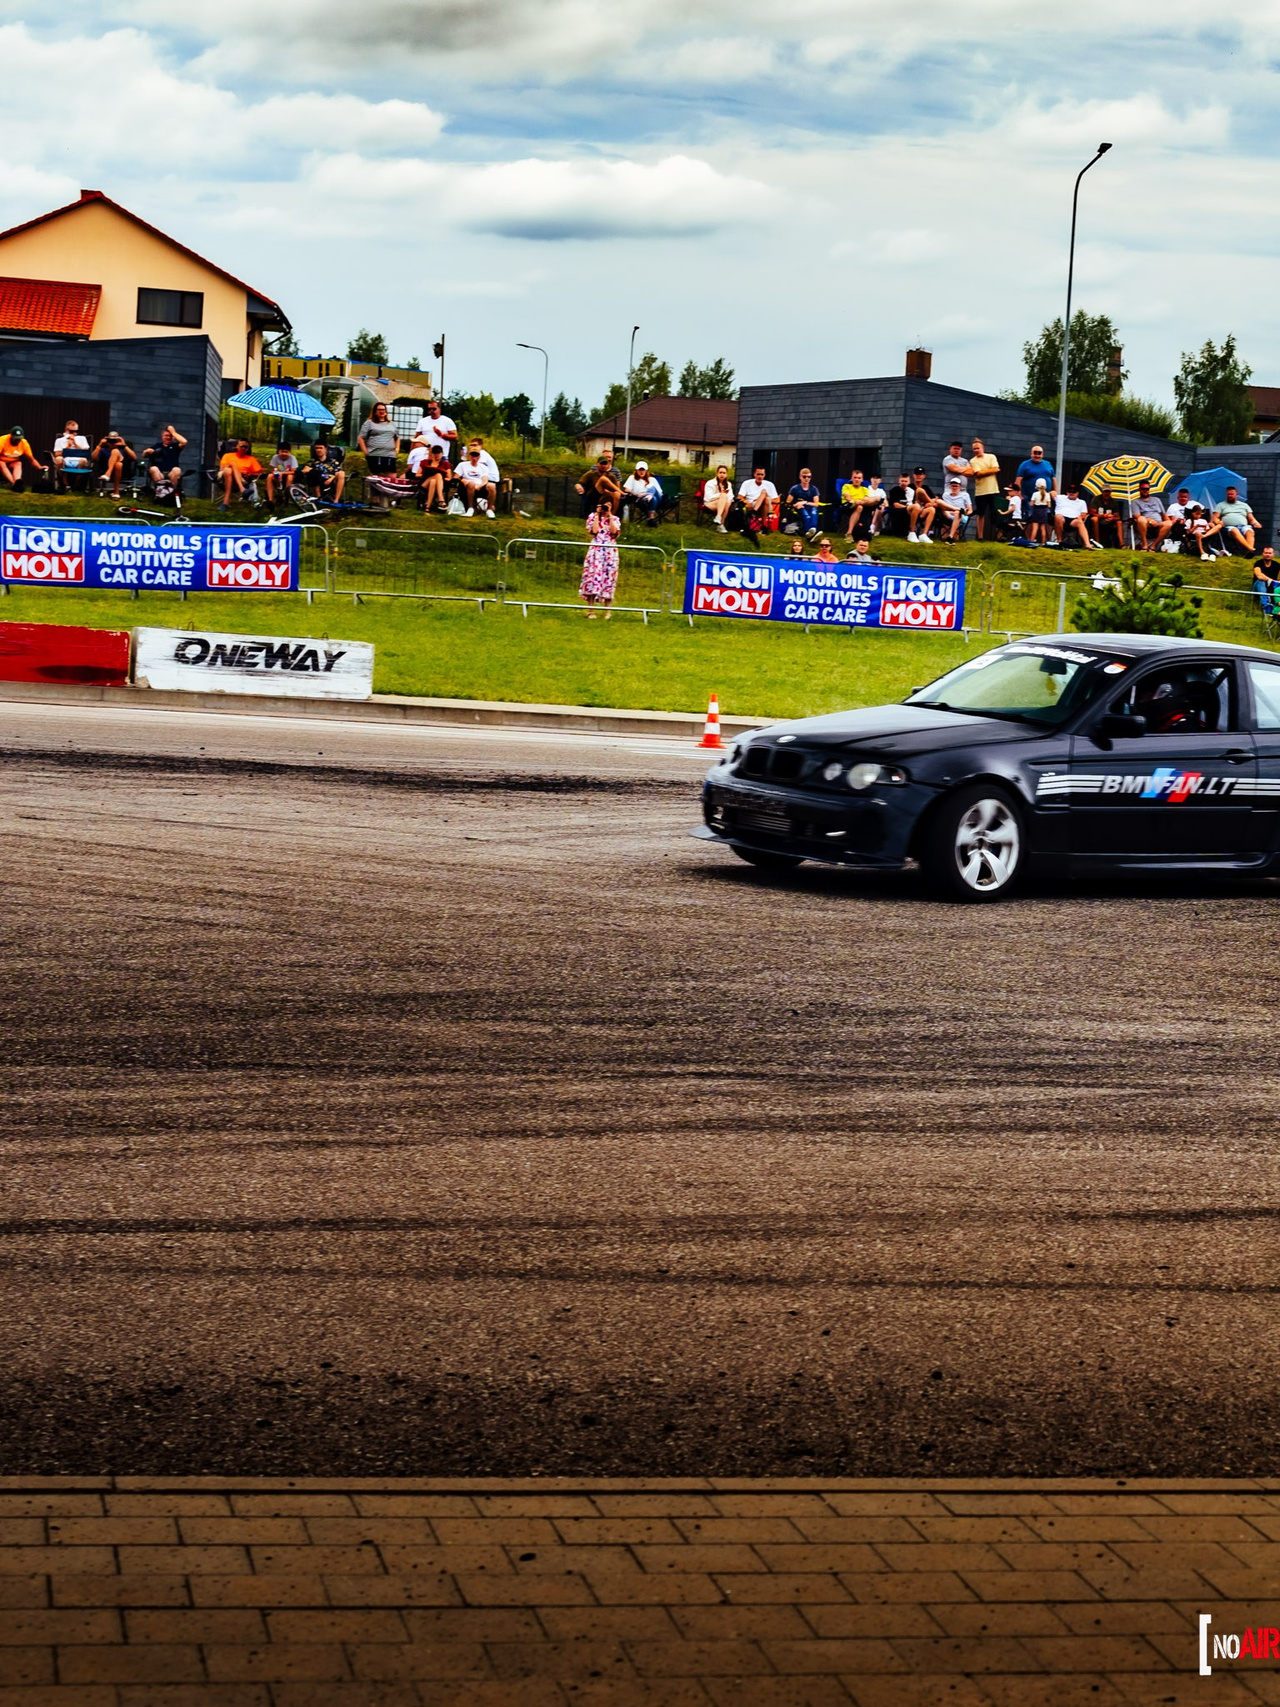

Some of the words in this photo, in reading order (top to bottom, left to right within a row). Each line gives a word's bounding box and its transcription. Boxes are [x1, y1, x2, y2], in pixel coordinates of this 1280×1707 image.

[5, 527, 81, 553] LIQUI
[91, 532, 156, 549] MOTOR
[159, 533, 202, 551] OILS
[212, 537, 287, 562] LIQUI
[5, 554, 82, 579] MOLY
[97, 550, 195, 568] ADDITIVES
[100, 567, 138, 584] CAR
[141, 568, 192, 586] CARE
[212, 563, 289, 586] MOLY
[699, 562, 769, 589] LIQUI
[779, 568, 838, 588] MOTOR
[840, 573, 879, 591] OILS
[697, 588, 771, 613] MOLY
[783, 587, 871, 607] ADDITIVES
[886, 578, 954, 602] LIQUI
[784, 604, 819, 620] CAR
[822, 607, 867, 623] CARE
[884, 602, 954, 626] MOLY
[1102, 774, 1238, 795] BMWFAN.LT
